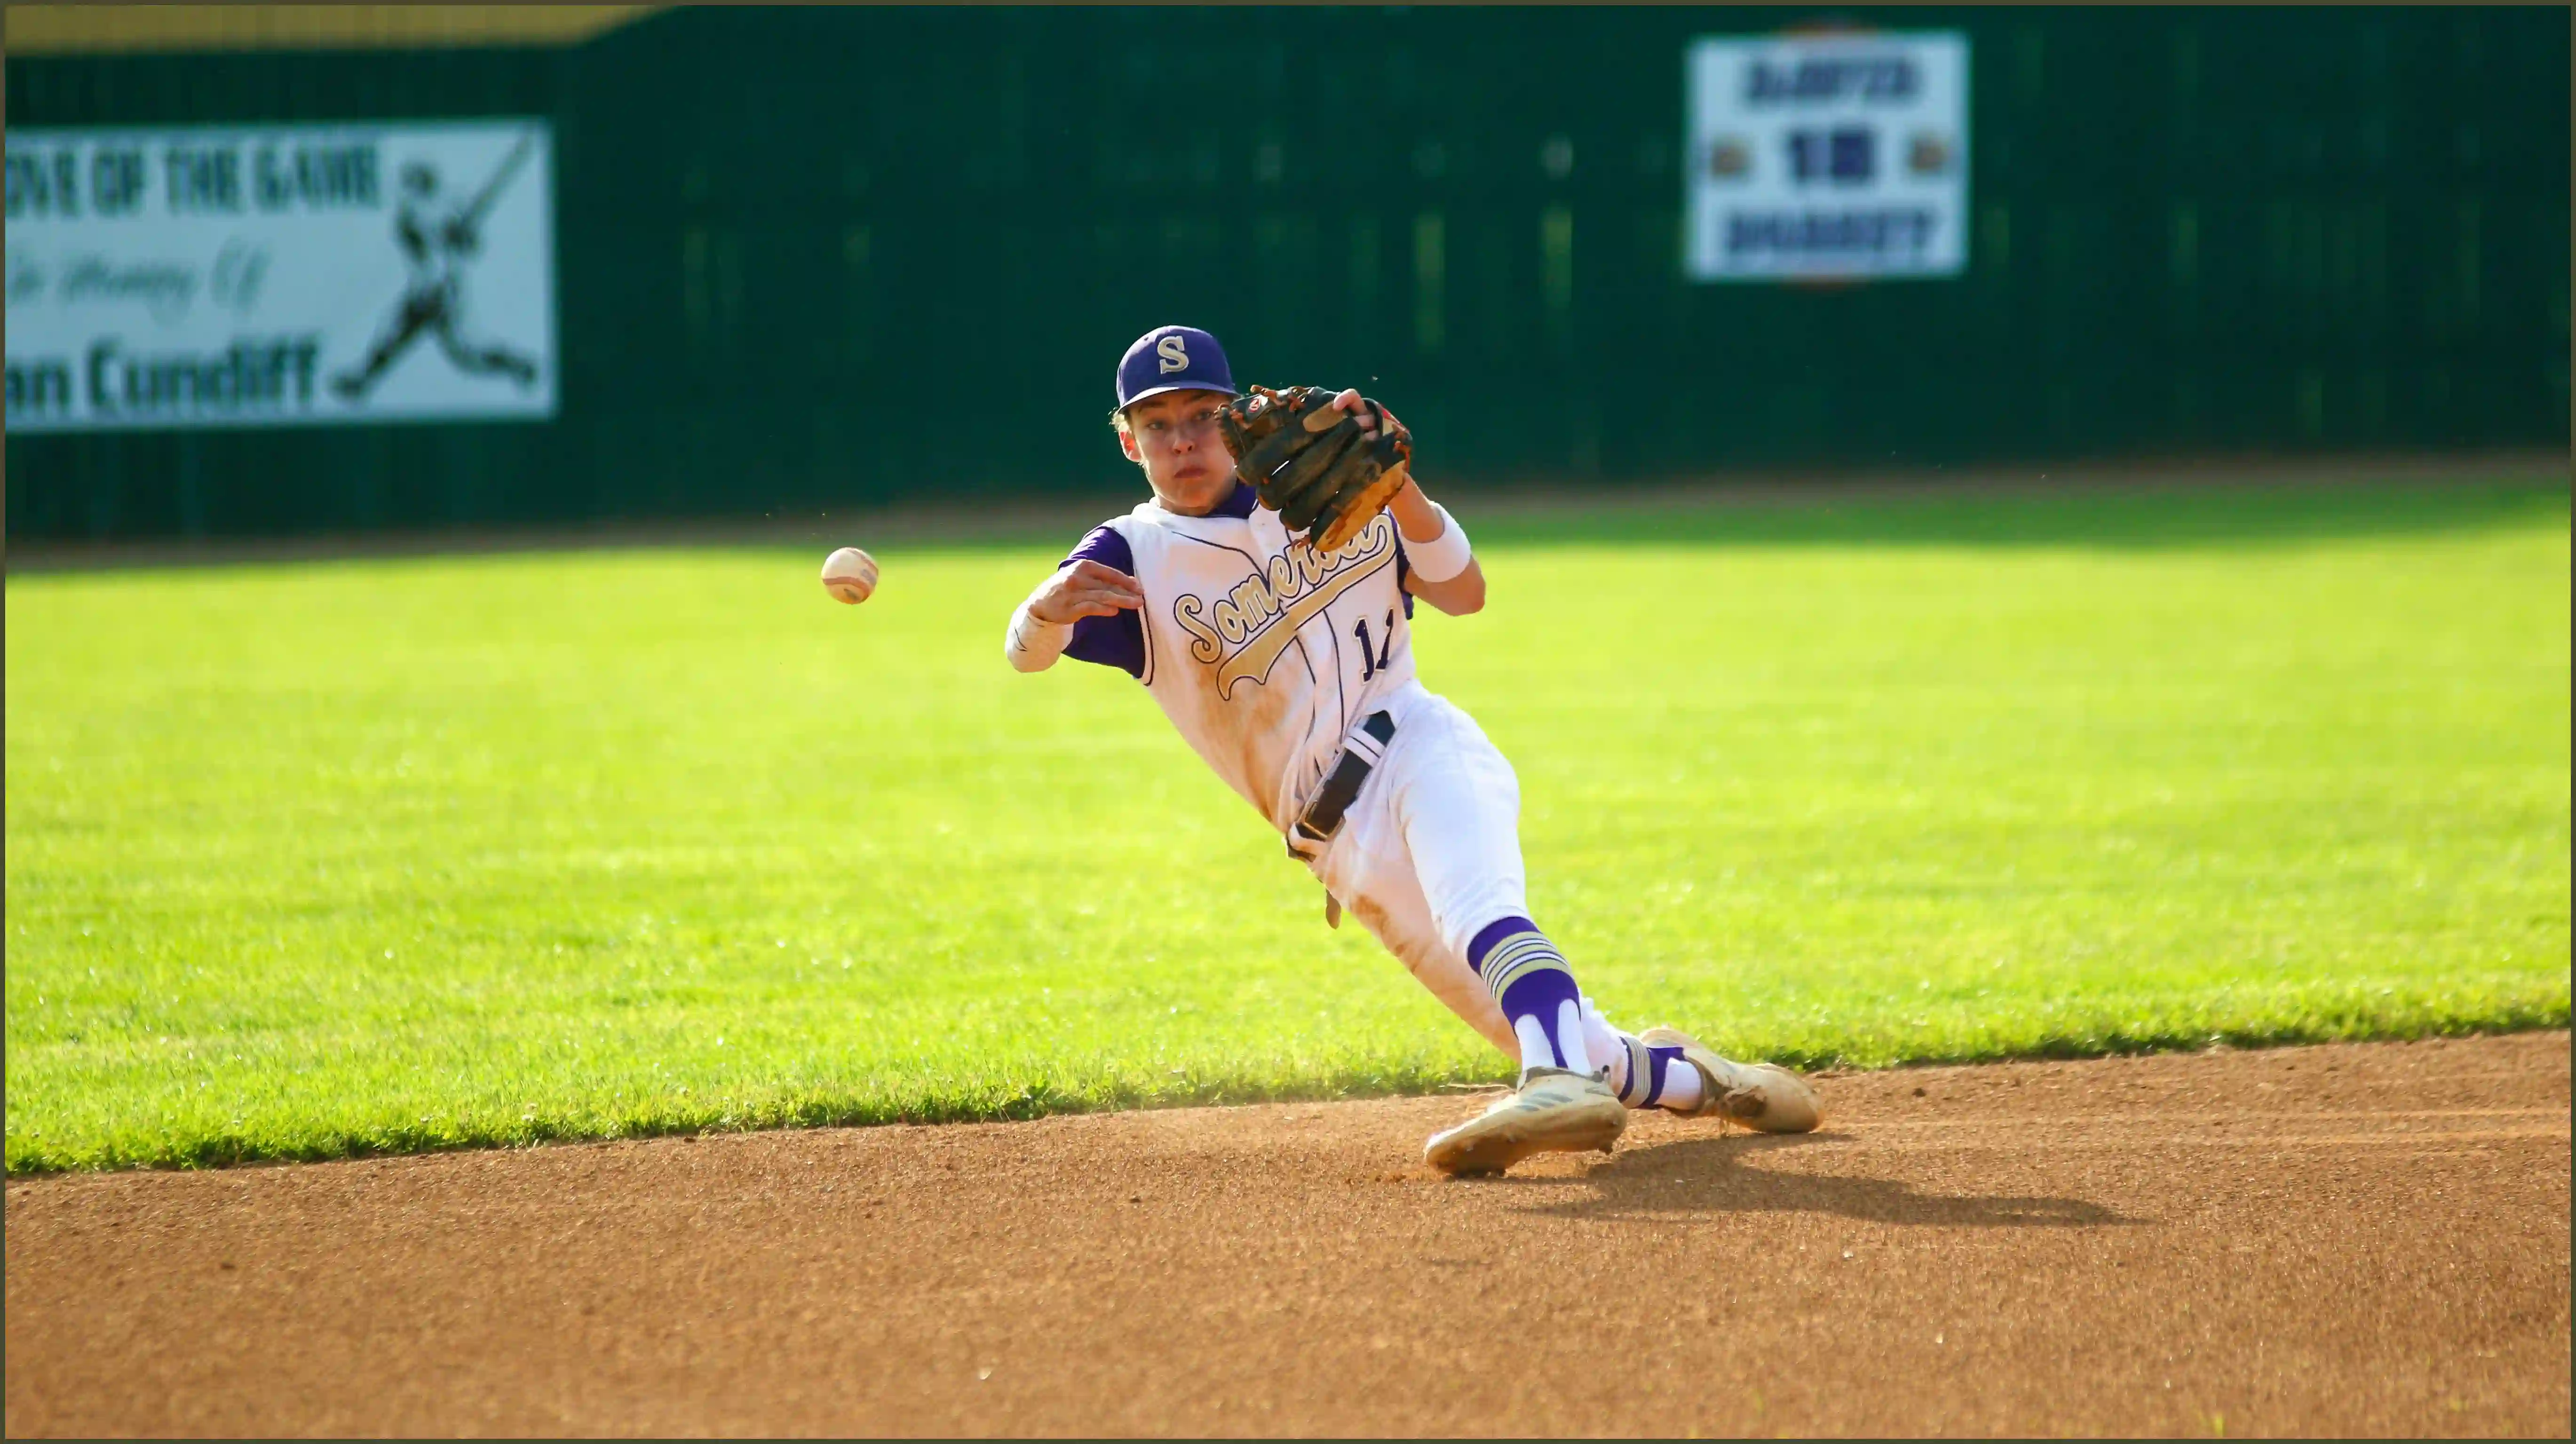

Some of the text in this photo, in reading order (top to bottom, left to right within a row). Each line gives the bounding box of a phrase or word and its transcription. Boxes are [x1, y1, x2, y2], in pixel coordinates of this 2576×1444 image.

[94, 149, 143, 214] OF
[164, 146, 238, 212] THE
[254, 143, 381, 210] GAME
[1157, 335, 1189, 374] S
